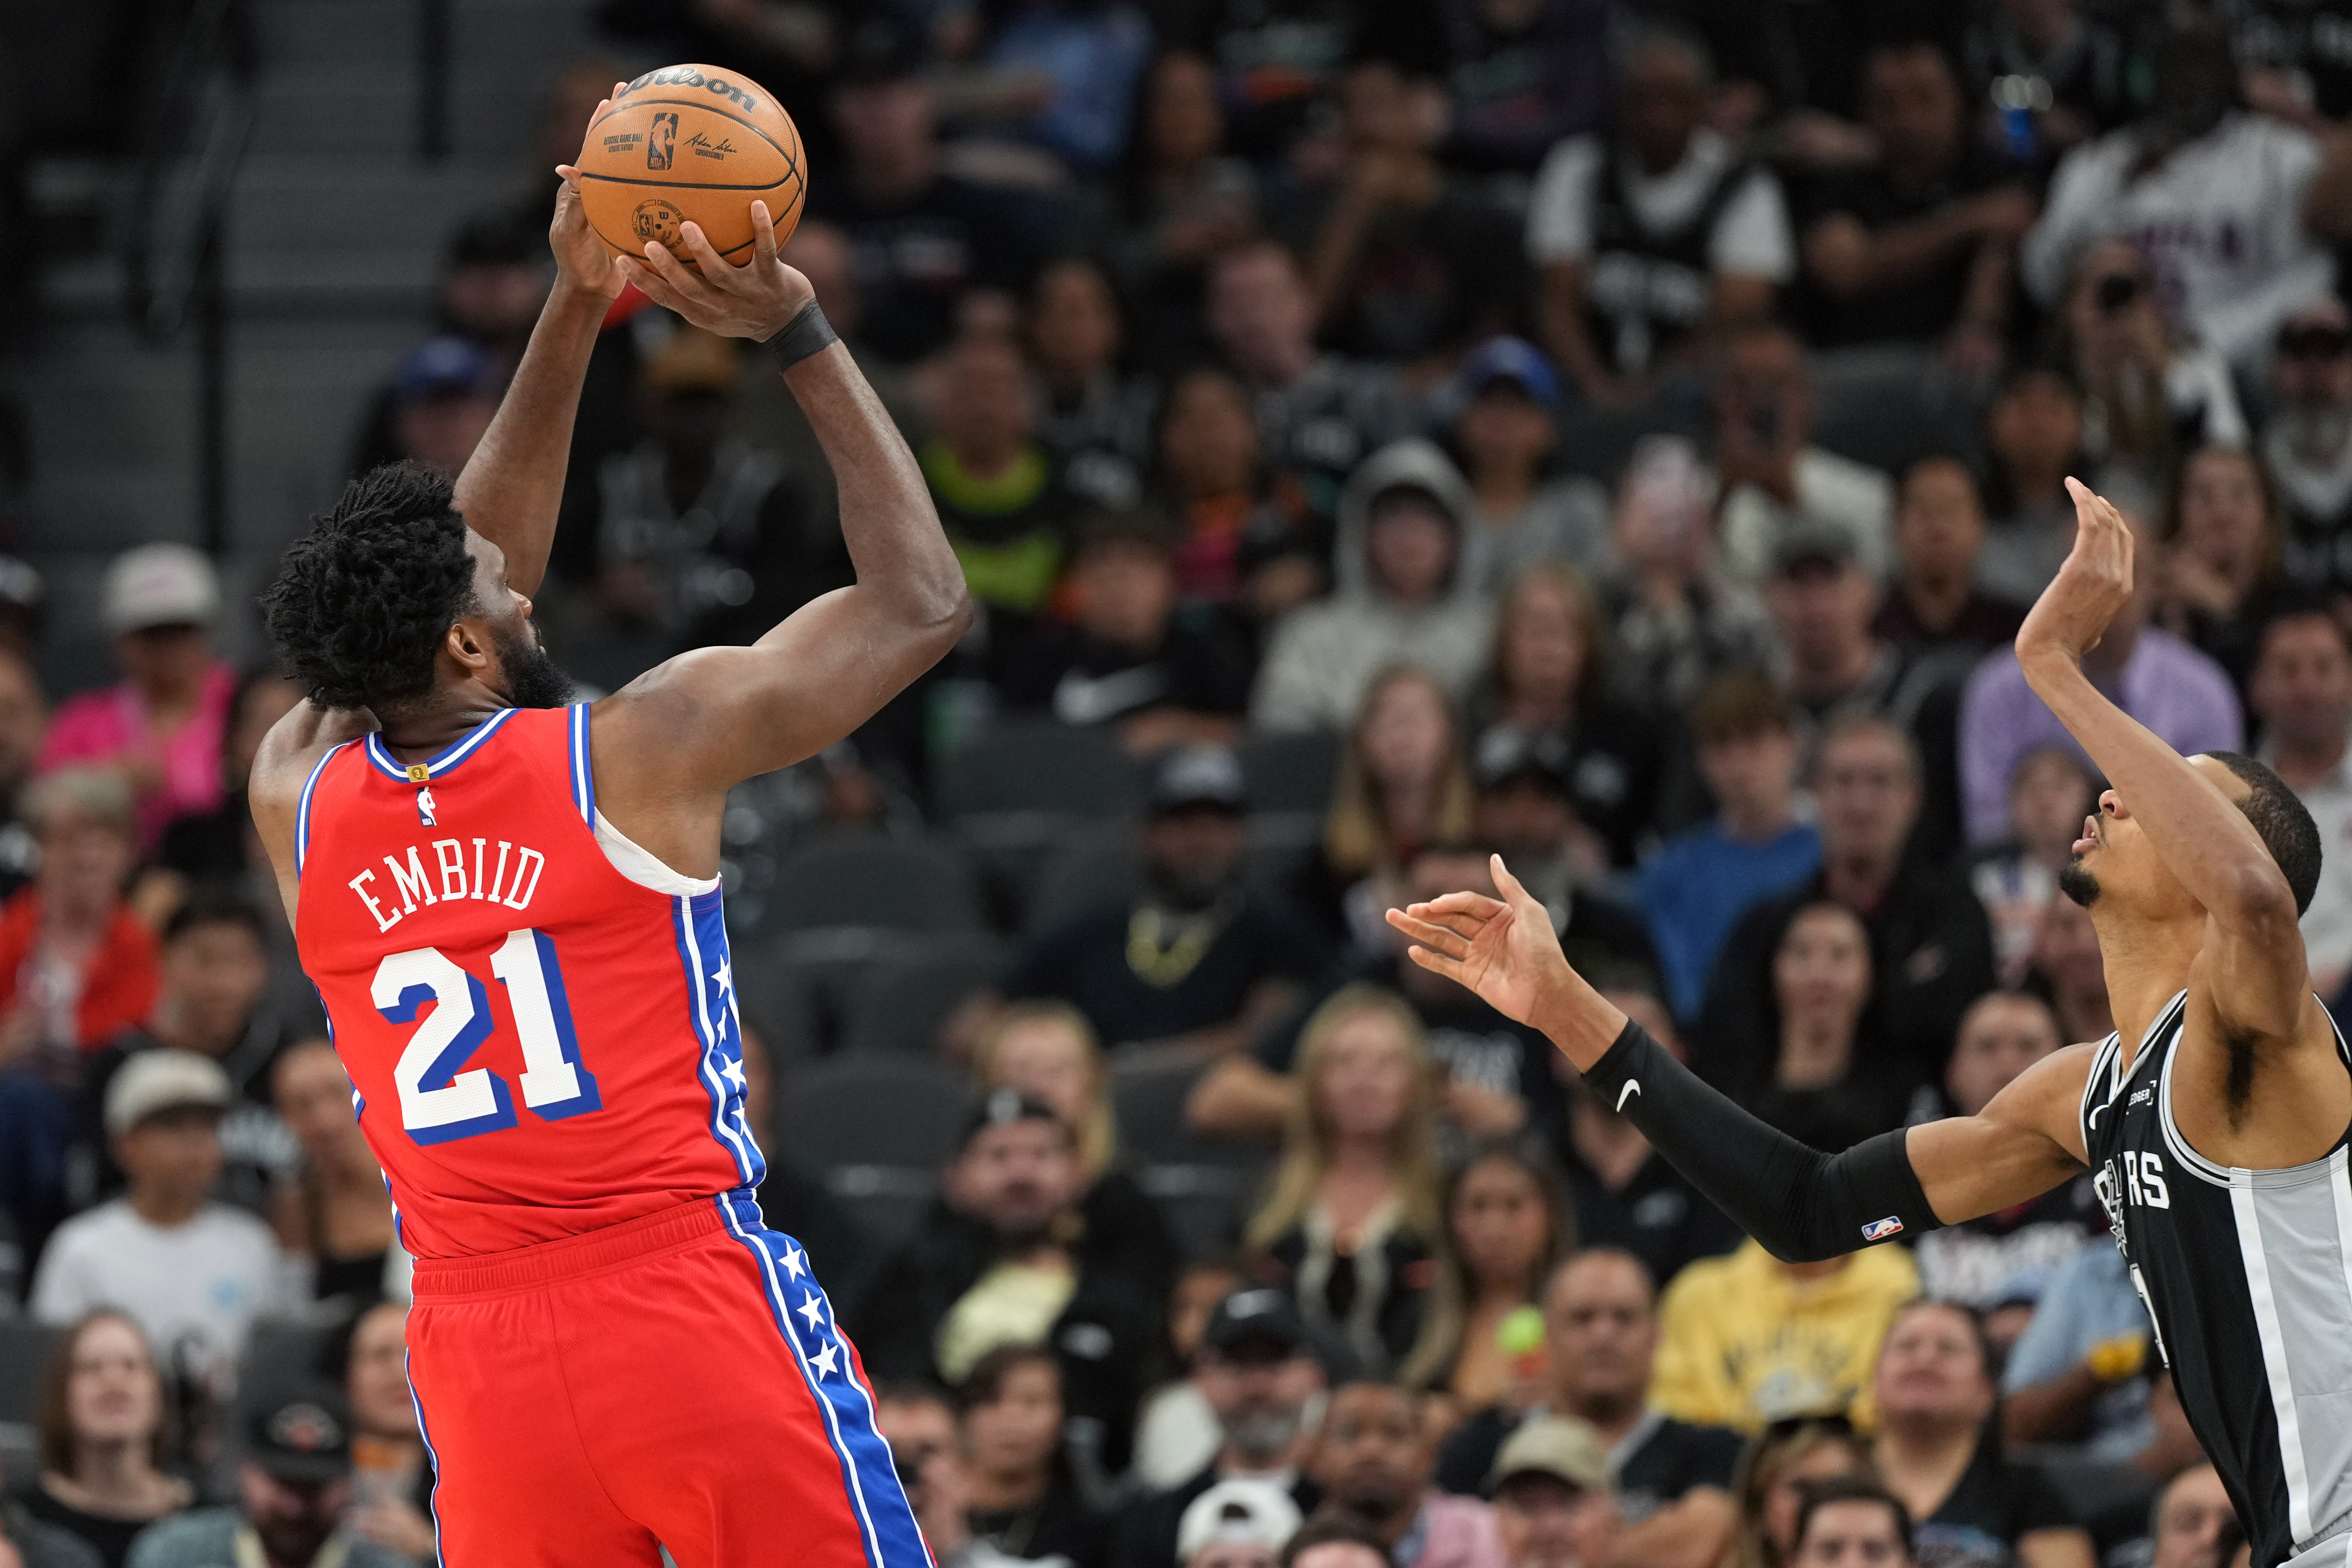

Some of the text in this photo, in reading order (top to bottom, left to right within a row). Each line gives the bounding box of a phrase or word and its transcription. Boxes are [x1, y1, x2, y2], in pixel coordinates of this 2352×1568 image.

[616, 67, 757, 115] Wilson
[695, 148, 724, 161] COMMISSIONER
[422, 817, 433, 826] NBA
[348, 838, 545, 934] EMBIID
[370, 927, 604, 1147] 21
[2129, 1088, 2150, 1106] EDGER
